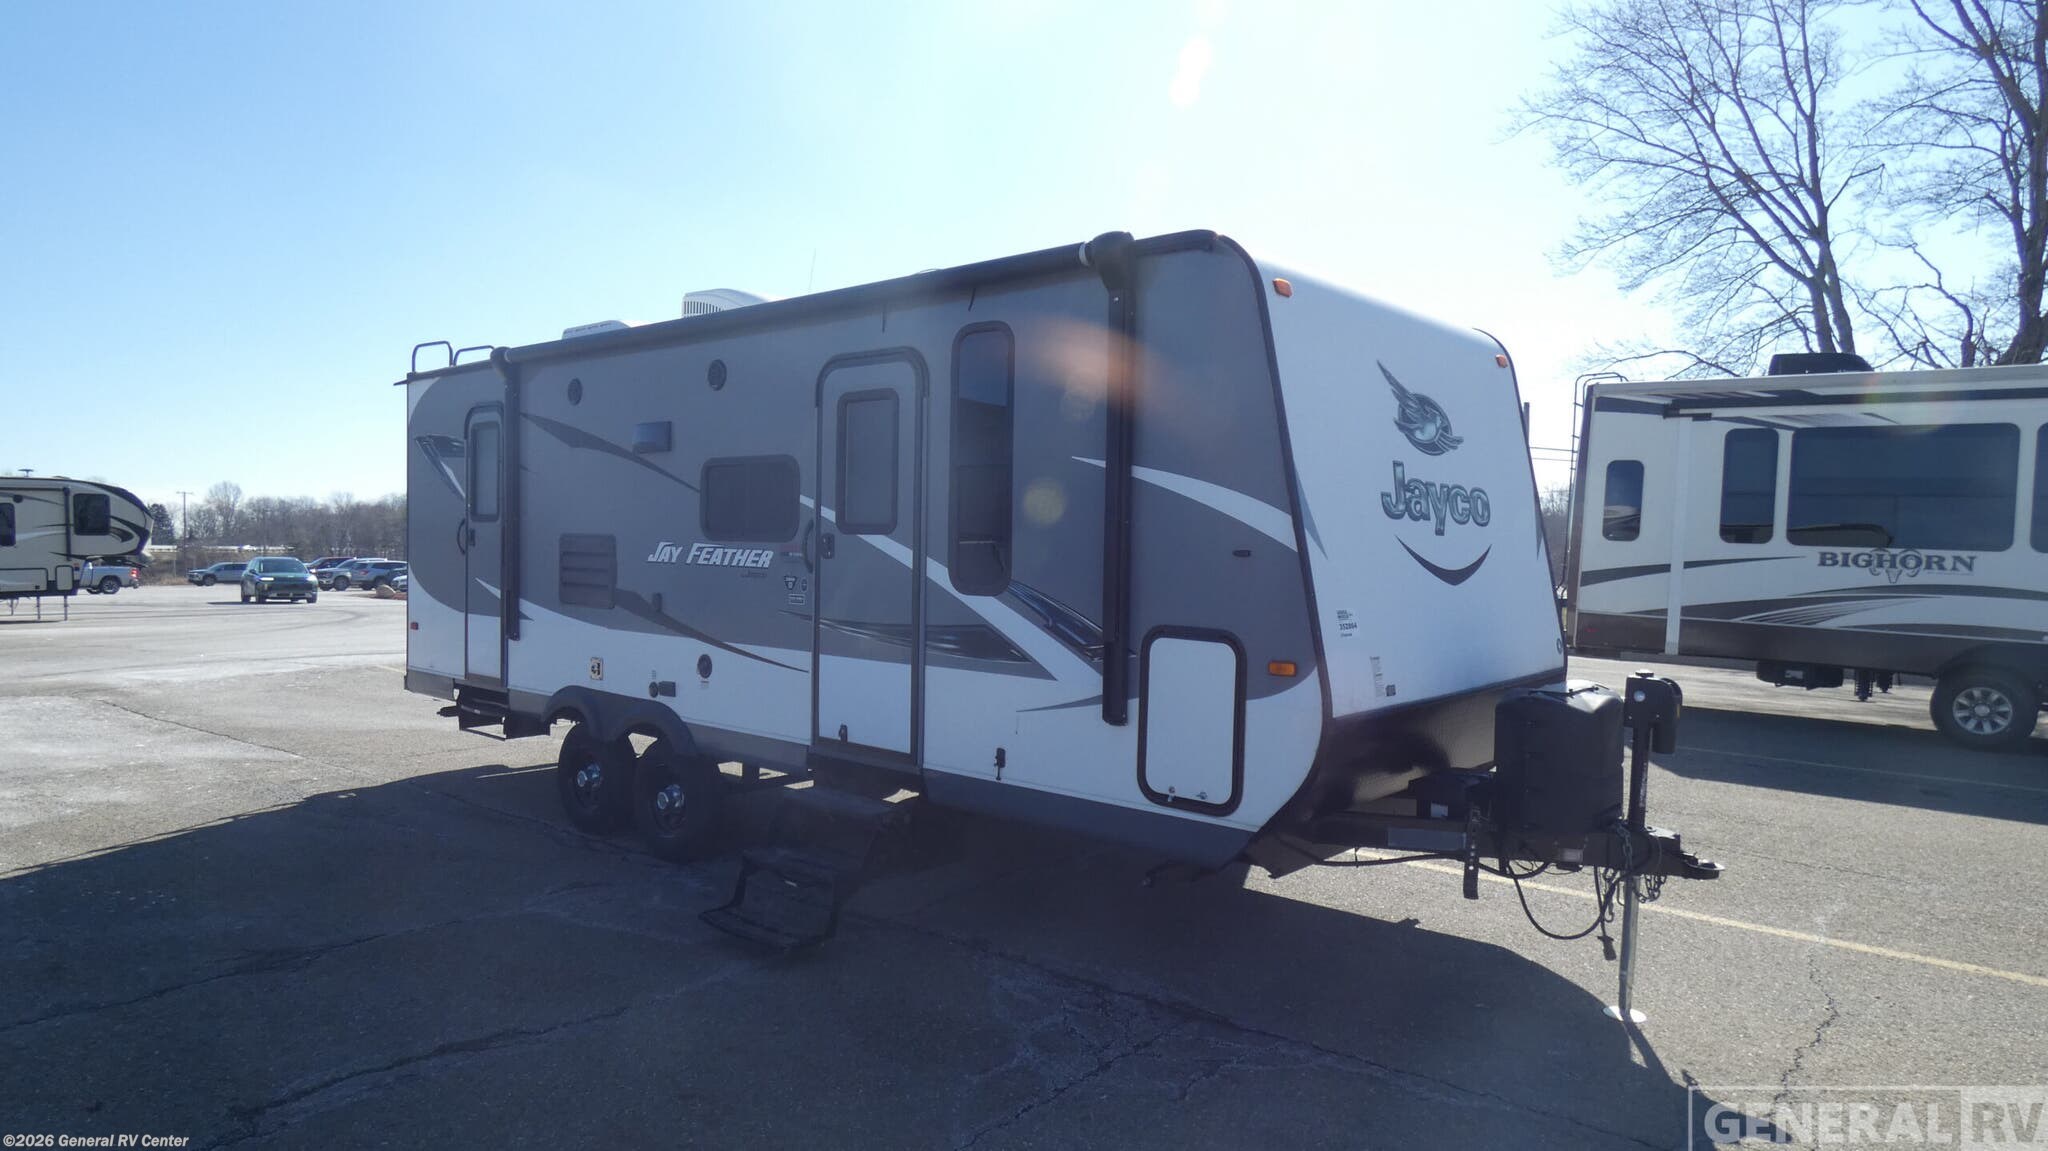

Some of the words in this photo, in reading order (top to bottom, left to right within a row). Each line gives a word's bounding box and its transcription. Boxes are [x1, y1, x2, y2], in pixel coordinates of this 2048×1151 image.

[1380, 460, 1491, 536] Jayco
[648, 541, 683, 563] JAY
[686, 542, 774, 568] FEATHER
[1817, 551, 1977, 572] BIGHORN
